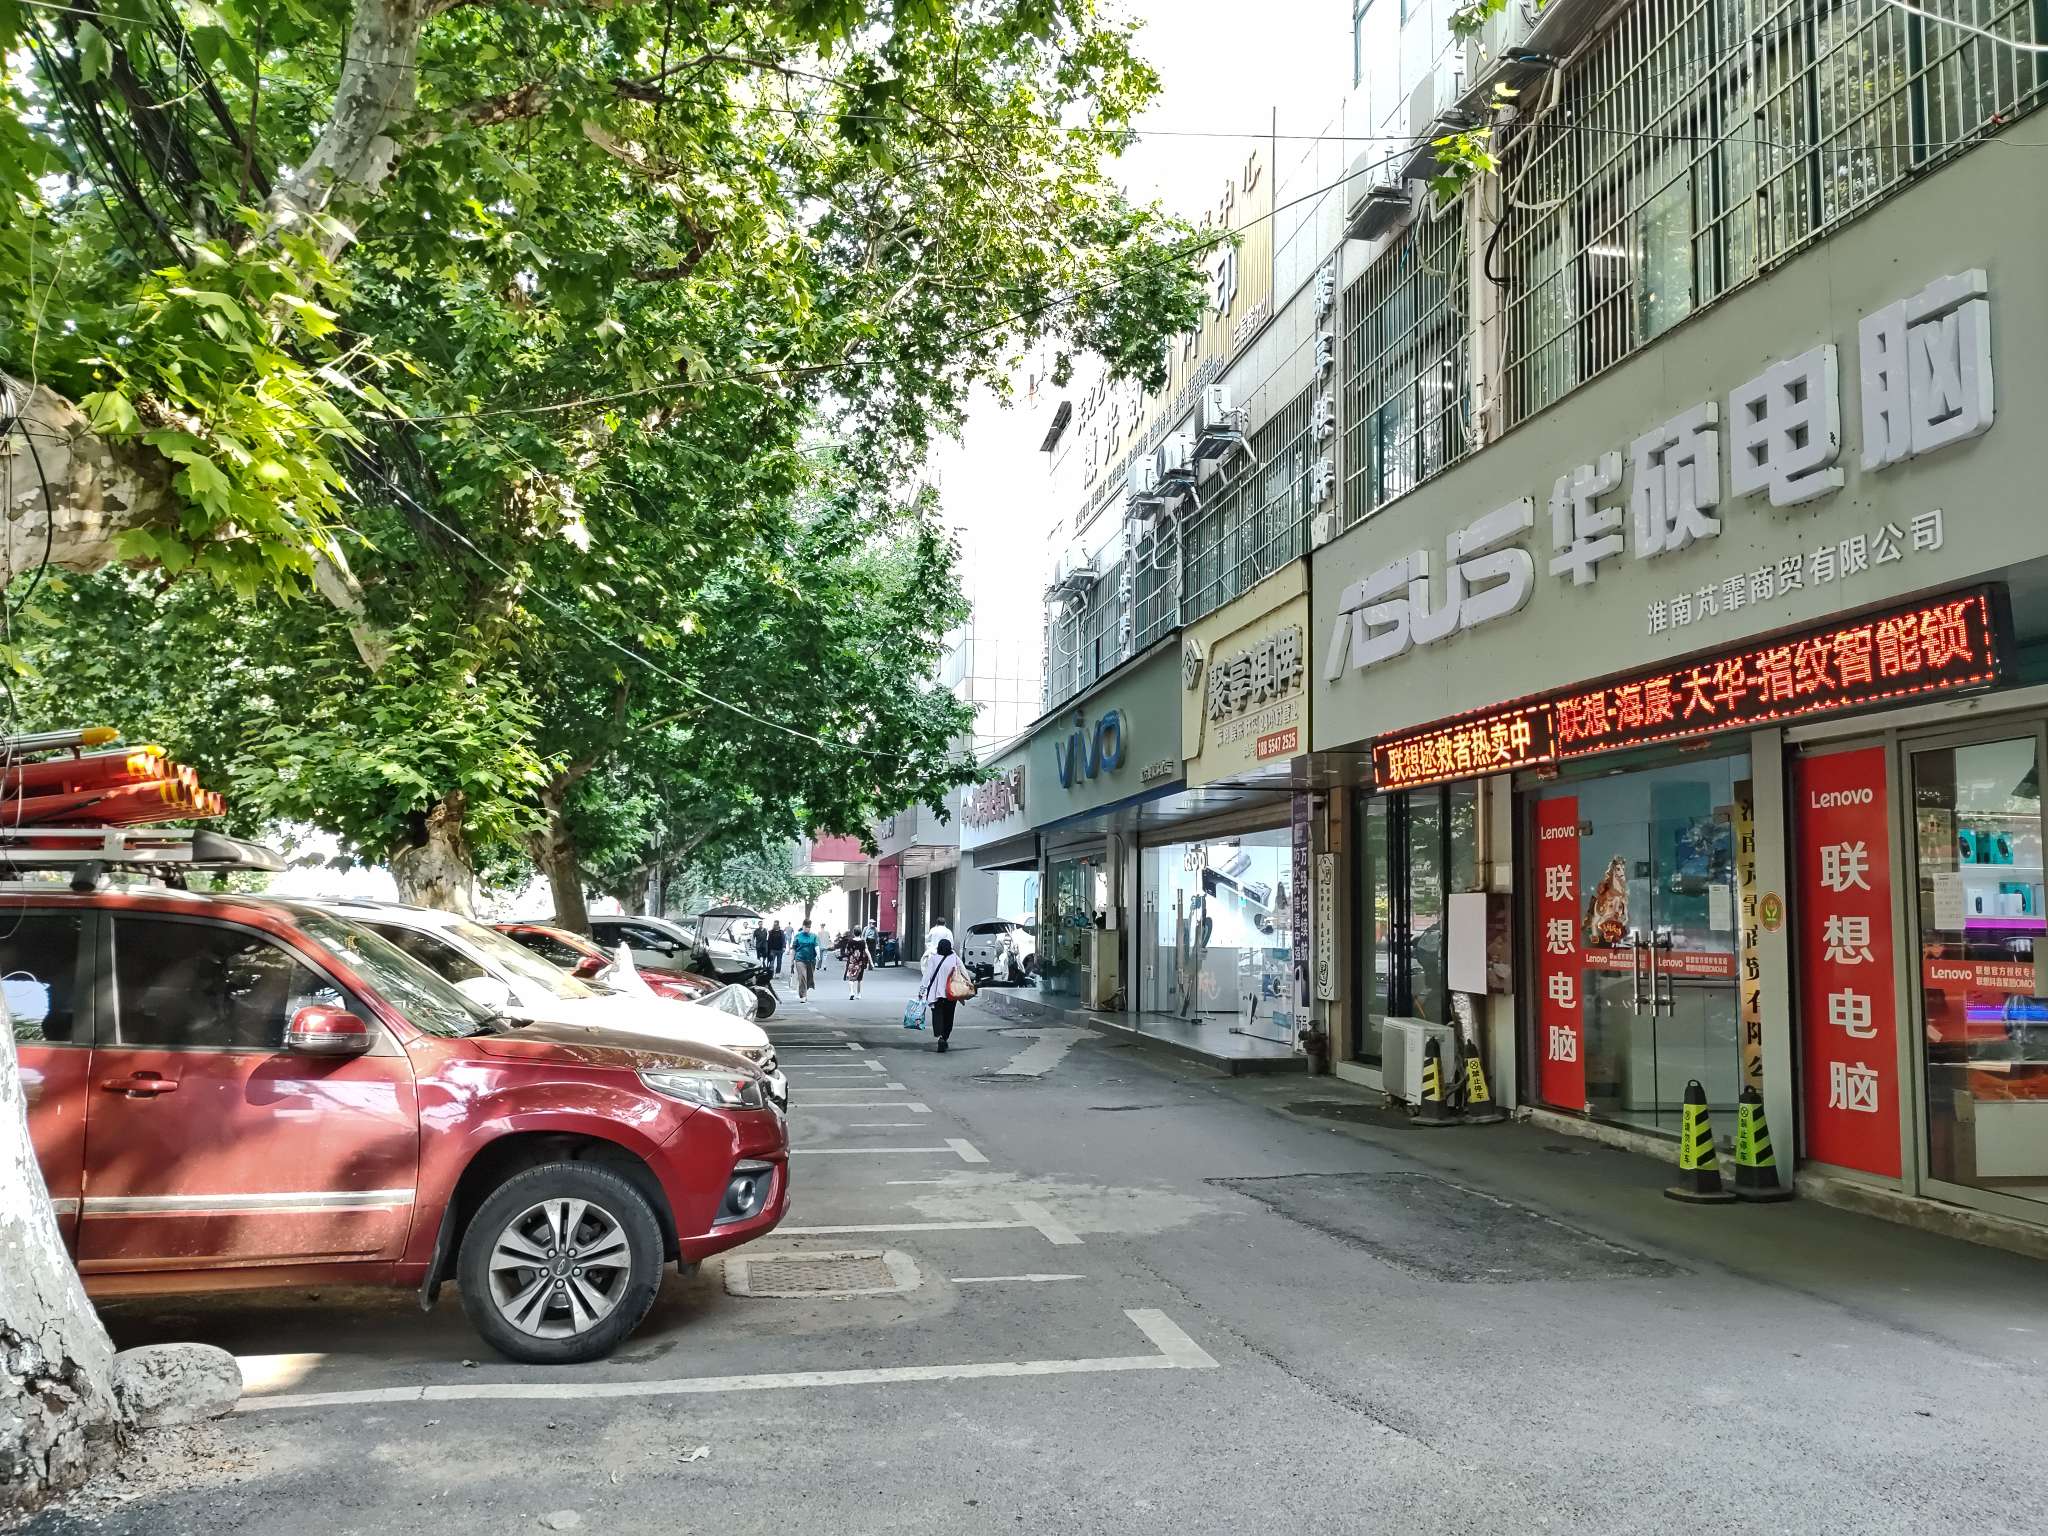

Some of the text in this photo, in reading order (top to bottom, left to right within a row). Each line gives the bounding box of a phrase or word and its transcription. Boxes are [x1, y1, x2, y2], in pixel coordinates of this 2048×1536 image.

[1323, 495, 1535, 682] ASUS
[1548, 267, 1995, 587] 华硕电脑
[1208, 625, 1303, 721] 聚享棋牌
[1055, 708, 1128, 790] vivo
[1388, 722, 1533, 784] 联想拯救者热卖中
[1811, 786, 1874, 809] Lenovo
[1540, 825, 1576, 841] Lenovo
[1544, 865, 1578, 1064] 联想电脑
[1585, 953, 1608, 964] Lenovo
[1658, 957, 1684, 968] Lenovo
[1820, 840, 1879, 1114] 联想电脑
[1931, 966, 1973, 980] Lenovo
